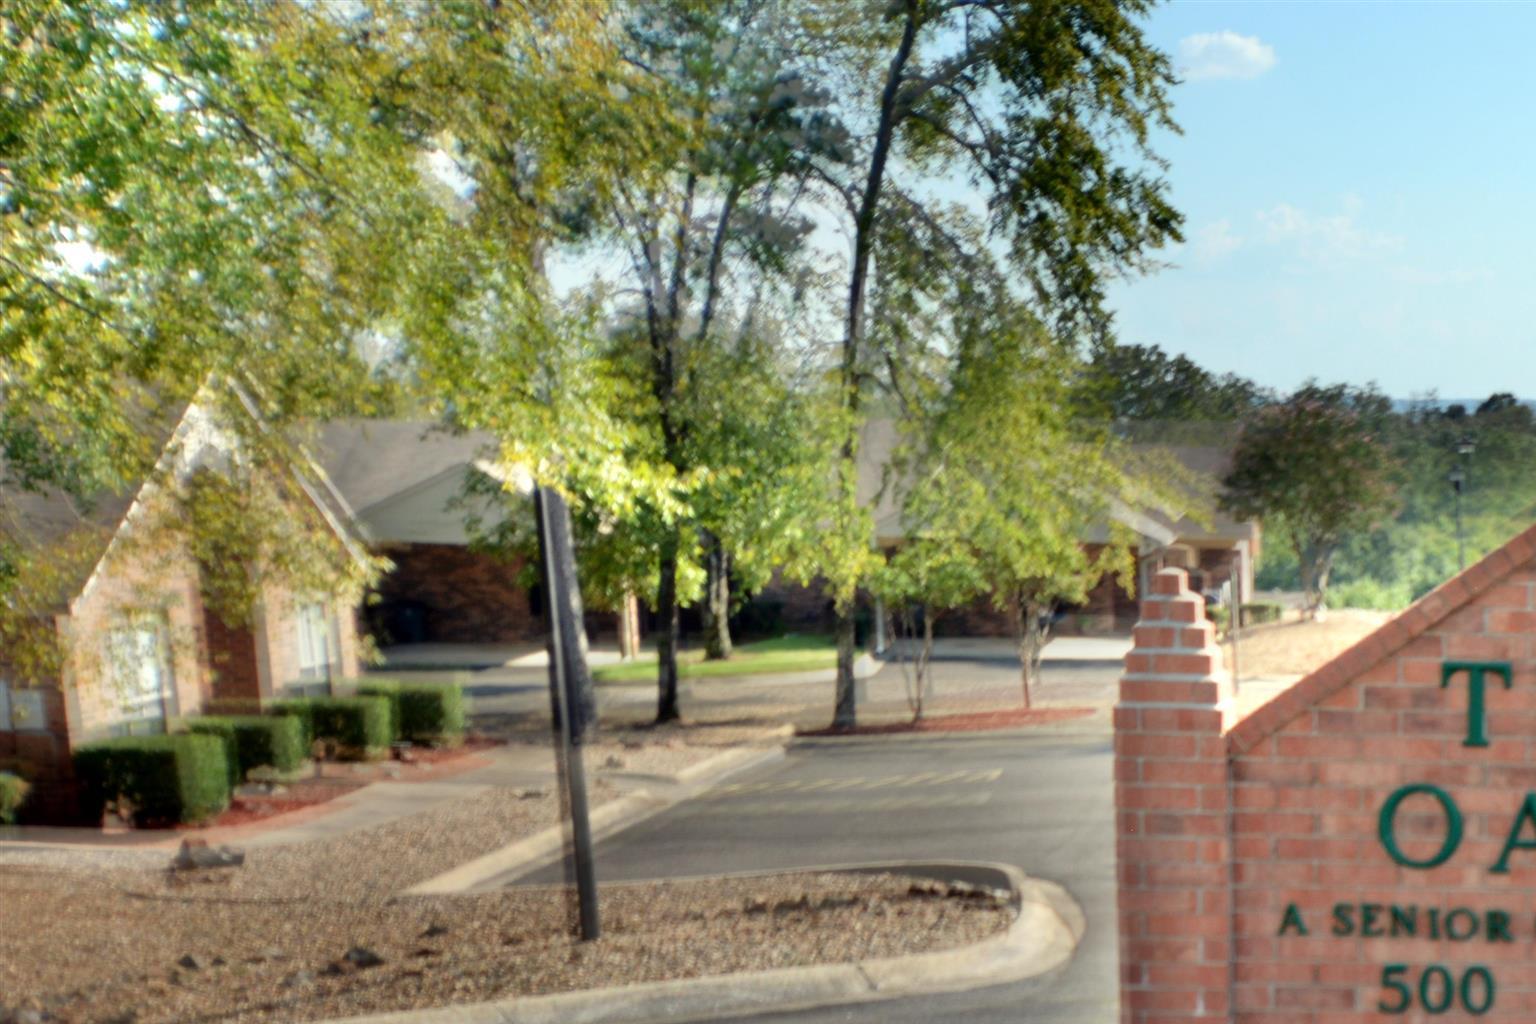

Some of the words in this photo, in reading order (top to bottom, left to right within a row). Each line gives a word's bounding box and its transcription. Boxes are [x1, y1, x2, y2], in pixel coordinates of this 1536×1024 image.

[1278, 902, 1309, 938] A
[1332, 903, 1514, 943] SENIOR
[1377, 964, 1497, 1016] 500
